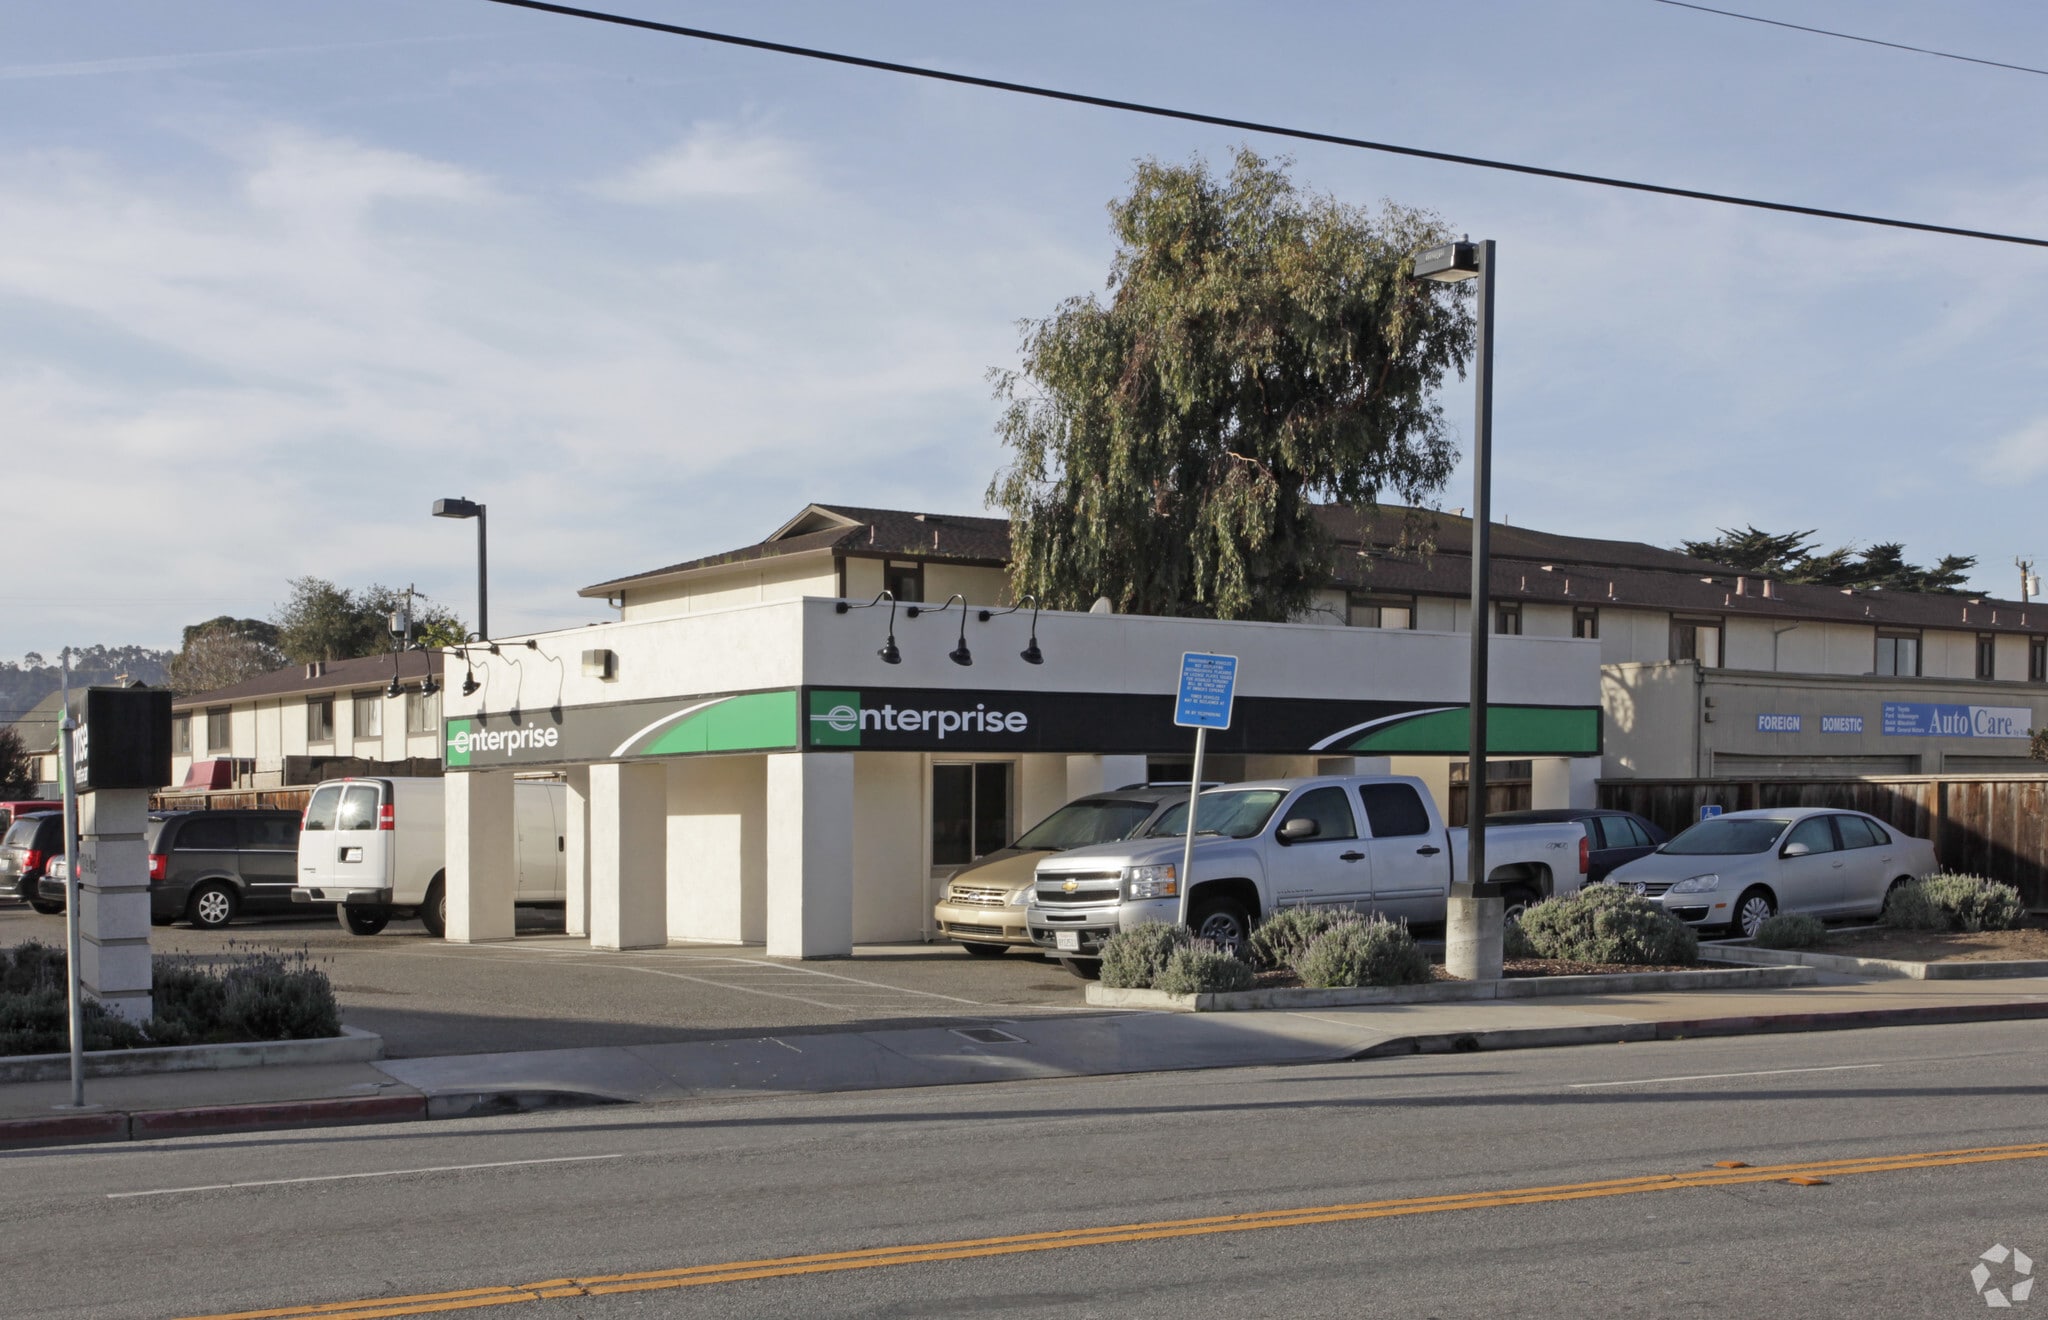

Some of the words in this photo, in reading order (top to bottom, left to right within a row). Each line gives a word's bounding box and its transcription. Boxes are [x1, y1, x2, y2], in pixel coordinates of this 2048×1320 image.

[811, 703, 1028, 739] enterprise
[1758, 716, 1800, 730] FOREIGN
[1822, 718, 1862, 732] DOMESTIC
[1928, 708, 1969, 735] Auto
[1974, 709, 2012, 735] Care
[448, 722, 559, 757] enterprise
